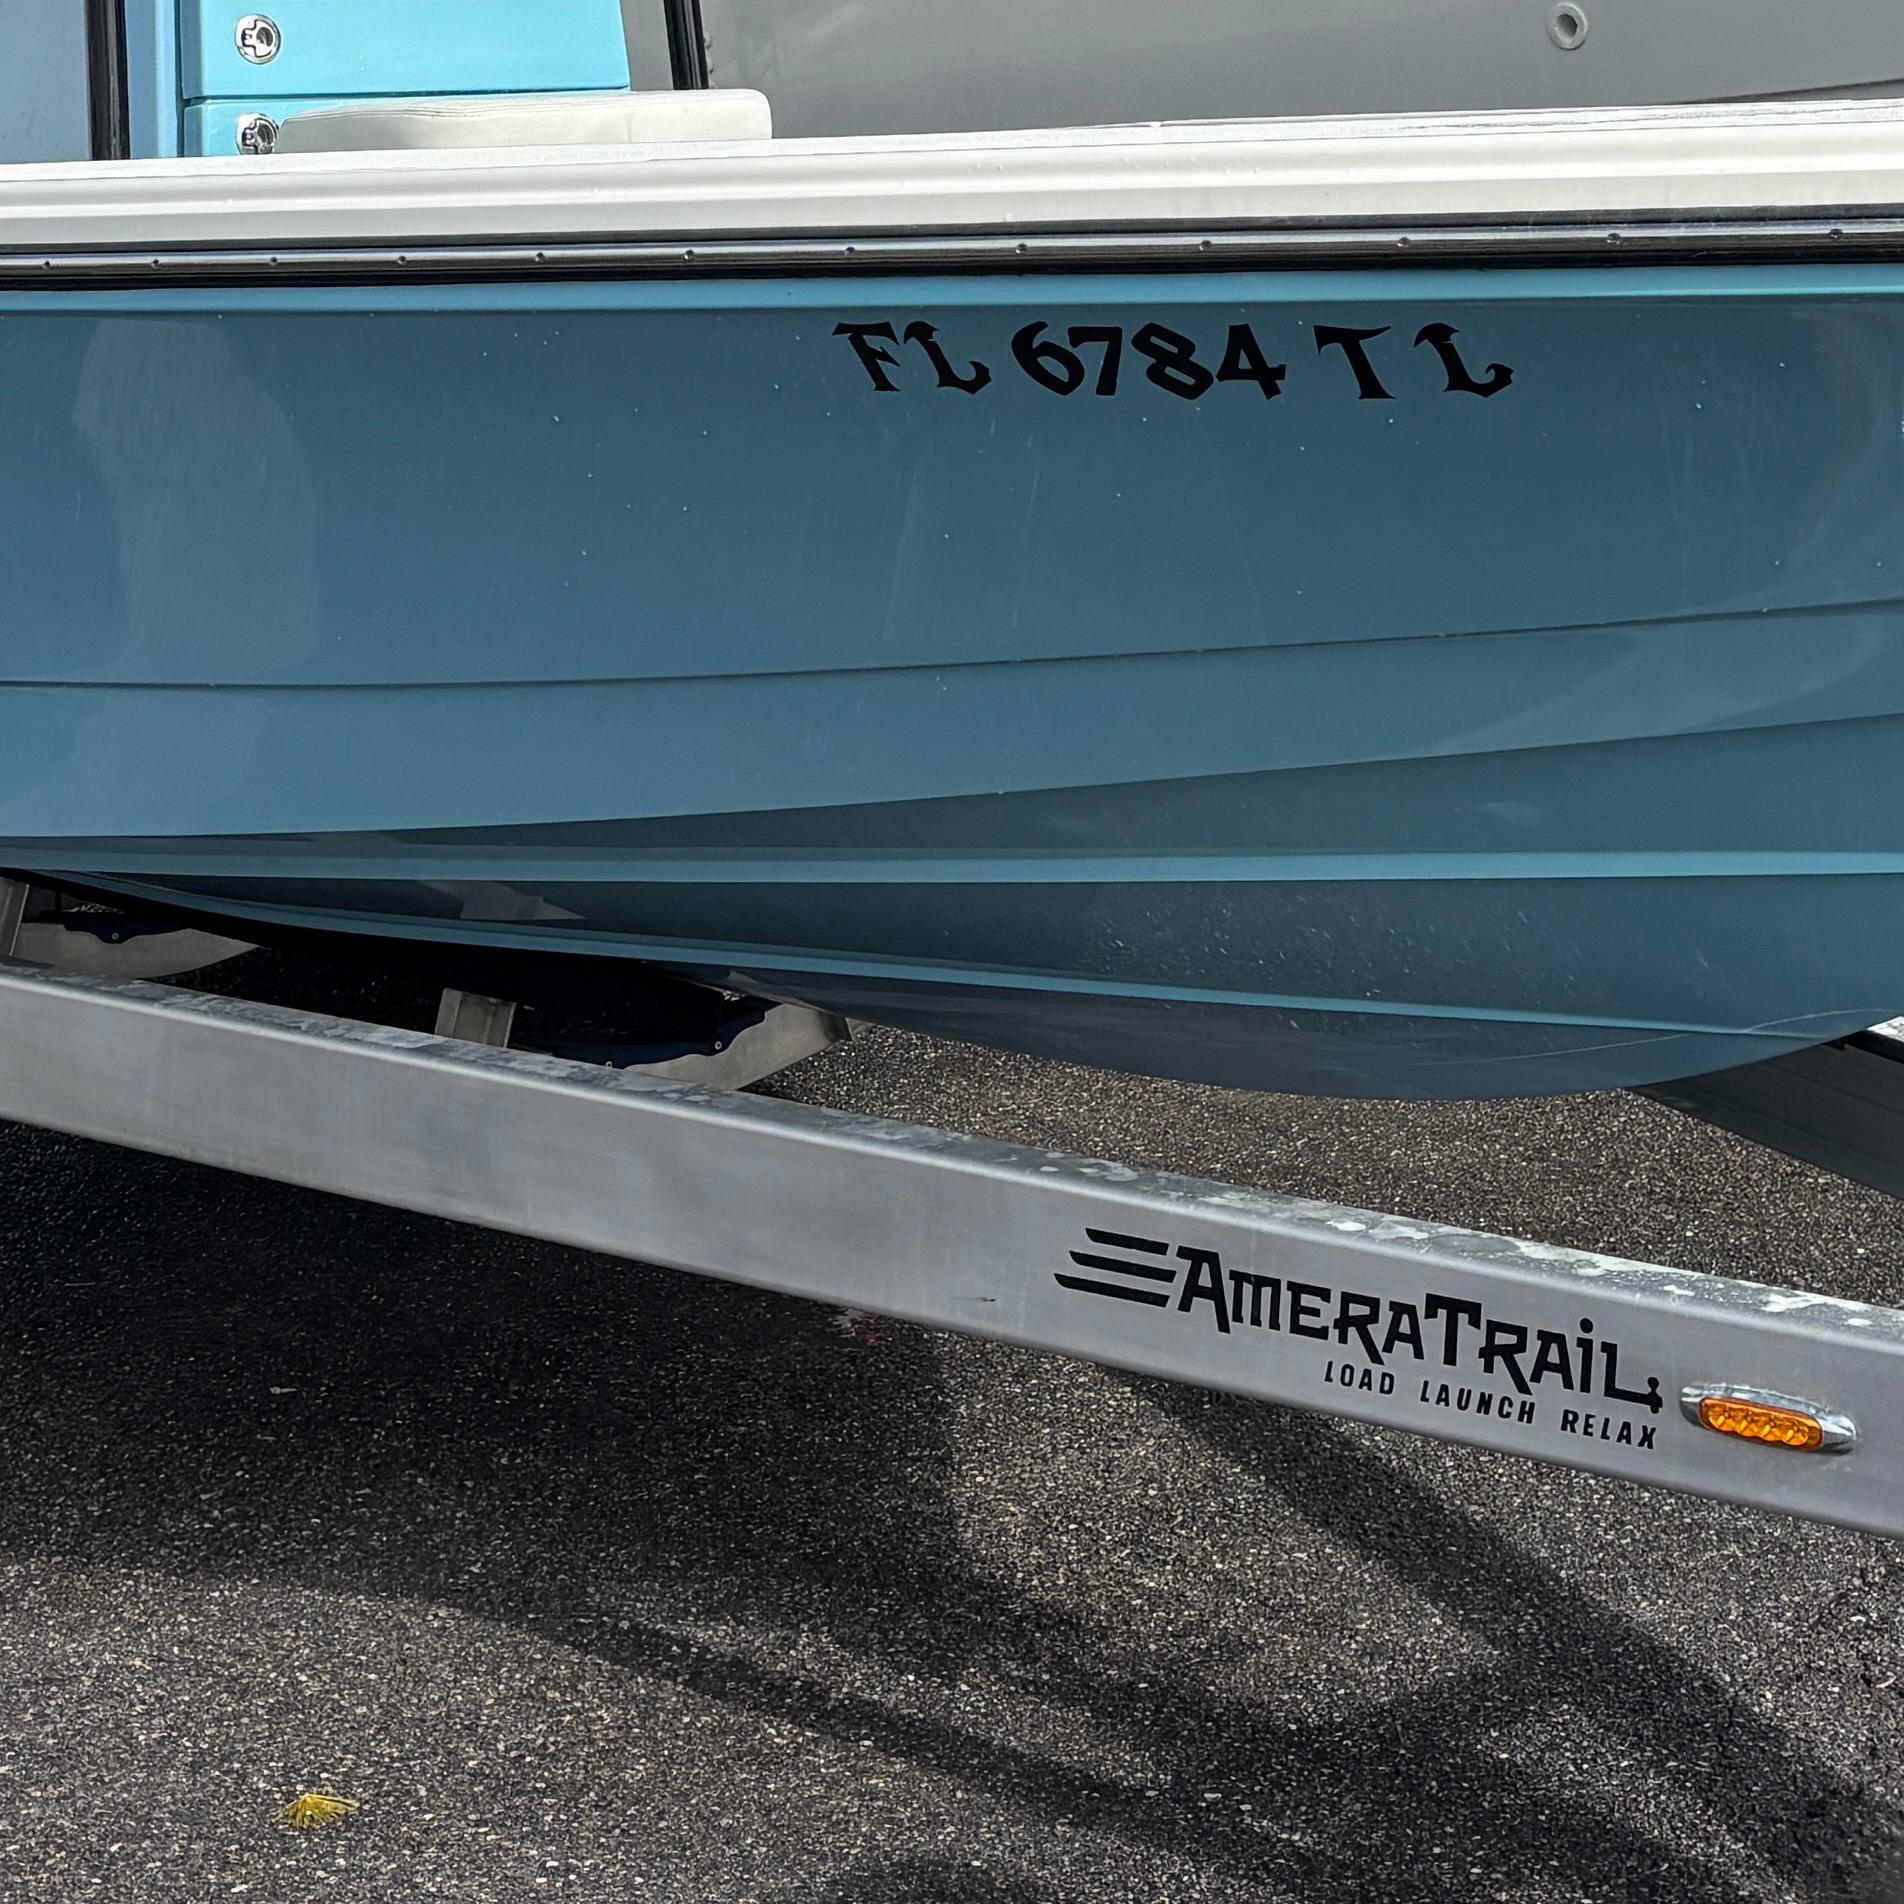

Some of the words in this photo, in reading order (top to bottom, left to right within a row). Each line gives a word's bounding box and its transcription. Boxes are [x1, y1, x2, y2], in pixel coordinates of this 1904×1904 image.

[832, 320, 992, 396] FL
[1010, 320, 1287, 401] 6784
[1324, 1360, 1396, 1396] LOAD
[1419, 1379, 1536, 1425] LAUNCH
[1559, 1409, 1658, 1450] RELAX
